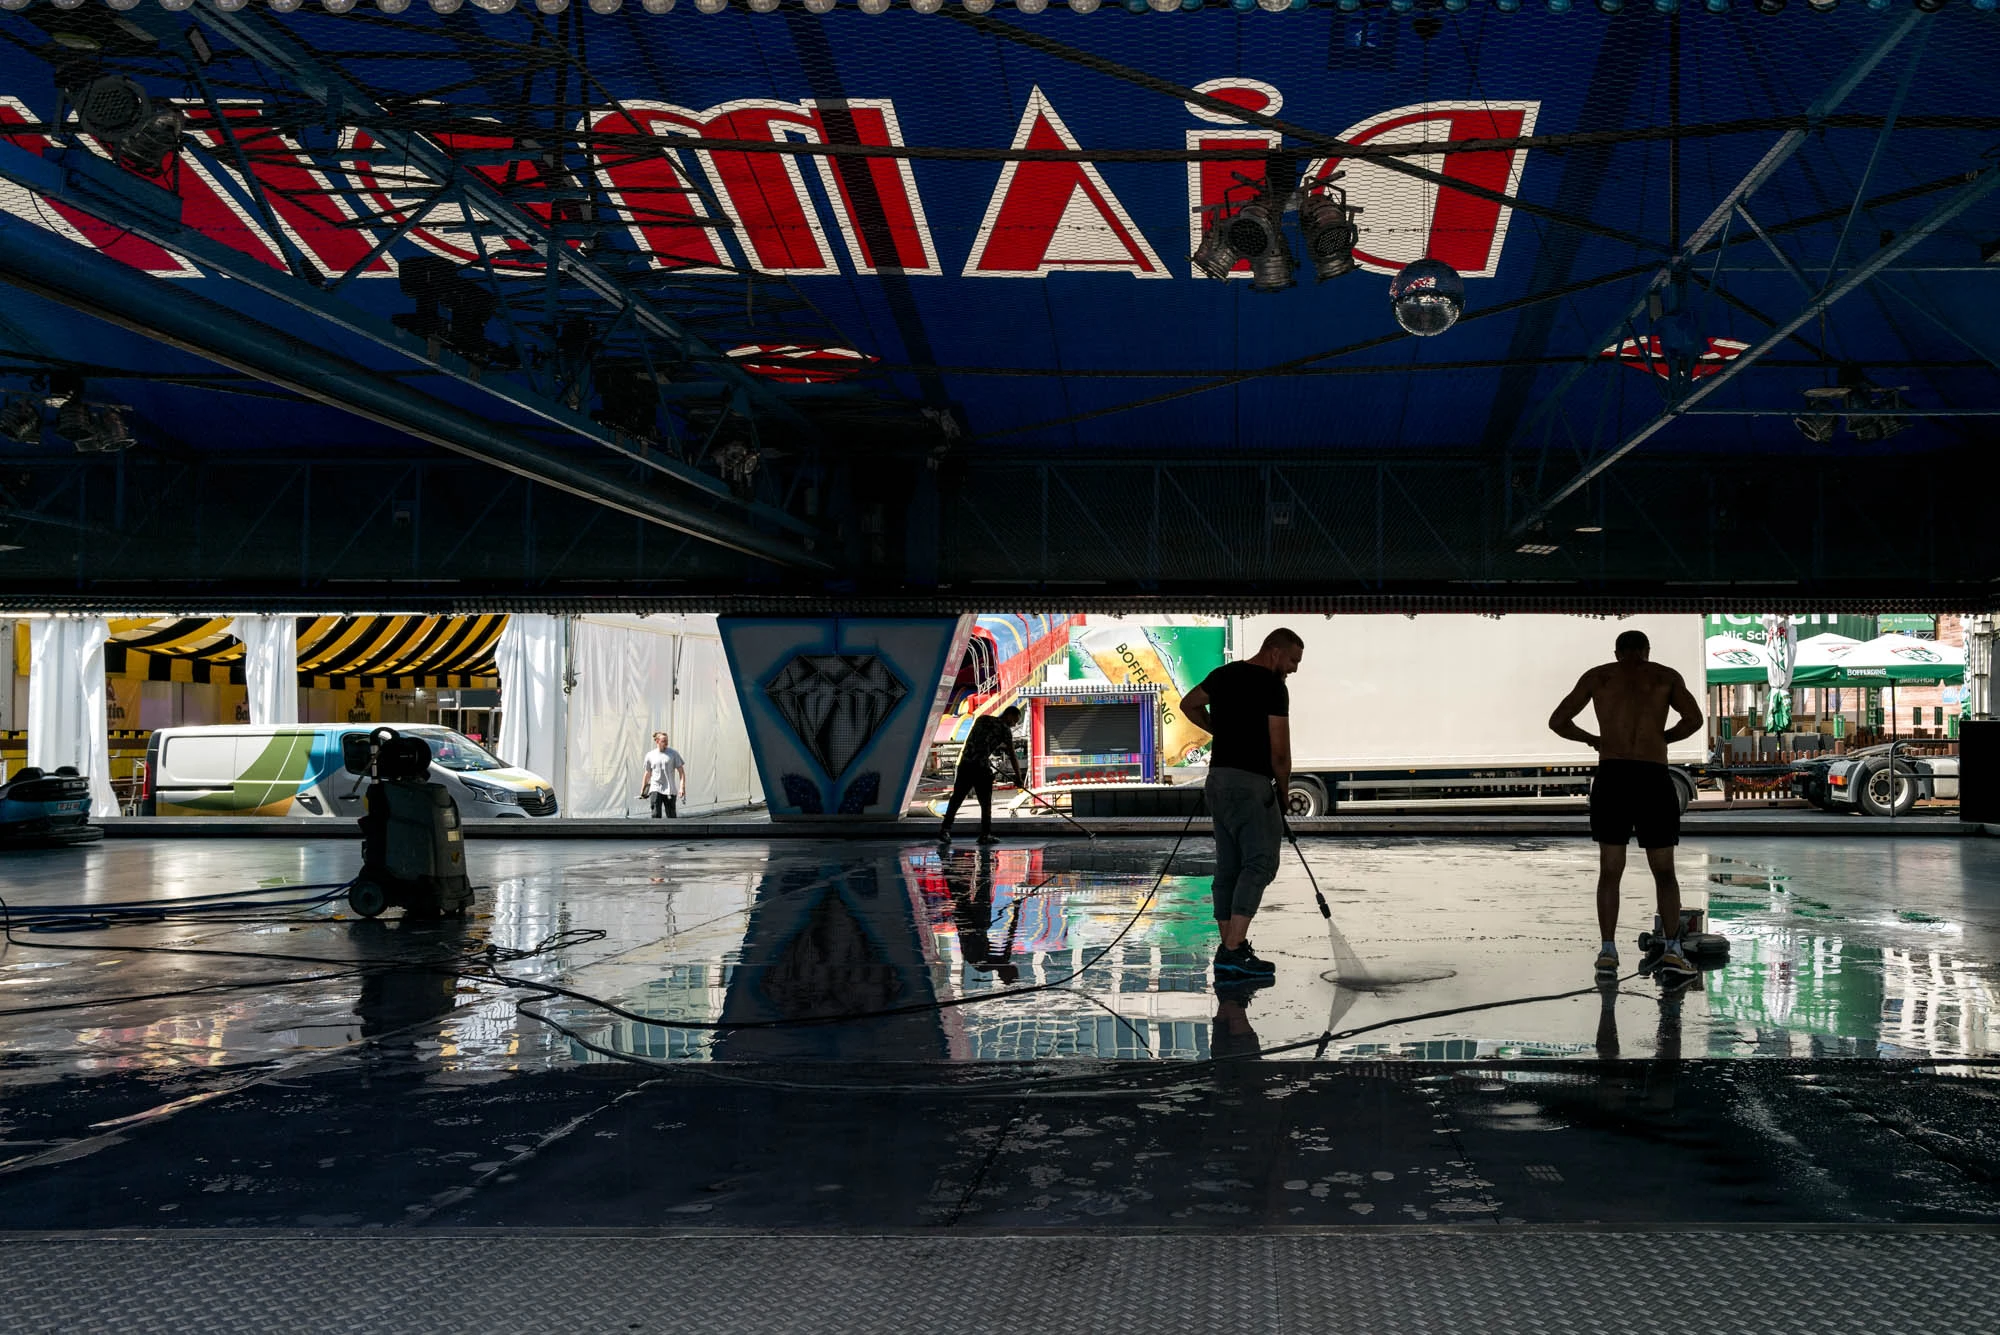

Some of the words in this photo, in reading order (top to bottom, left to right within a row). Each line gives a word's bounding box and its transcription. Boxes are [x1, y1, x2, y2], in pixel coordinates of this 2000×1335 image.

[1723, 630, 1743, 640] Nic
[1746, 630, 1768, 641] Sch
[1115, 642, 1176, 725] BOFFENG
[1056, 769, 1129, 785] CAISSE
